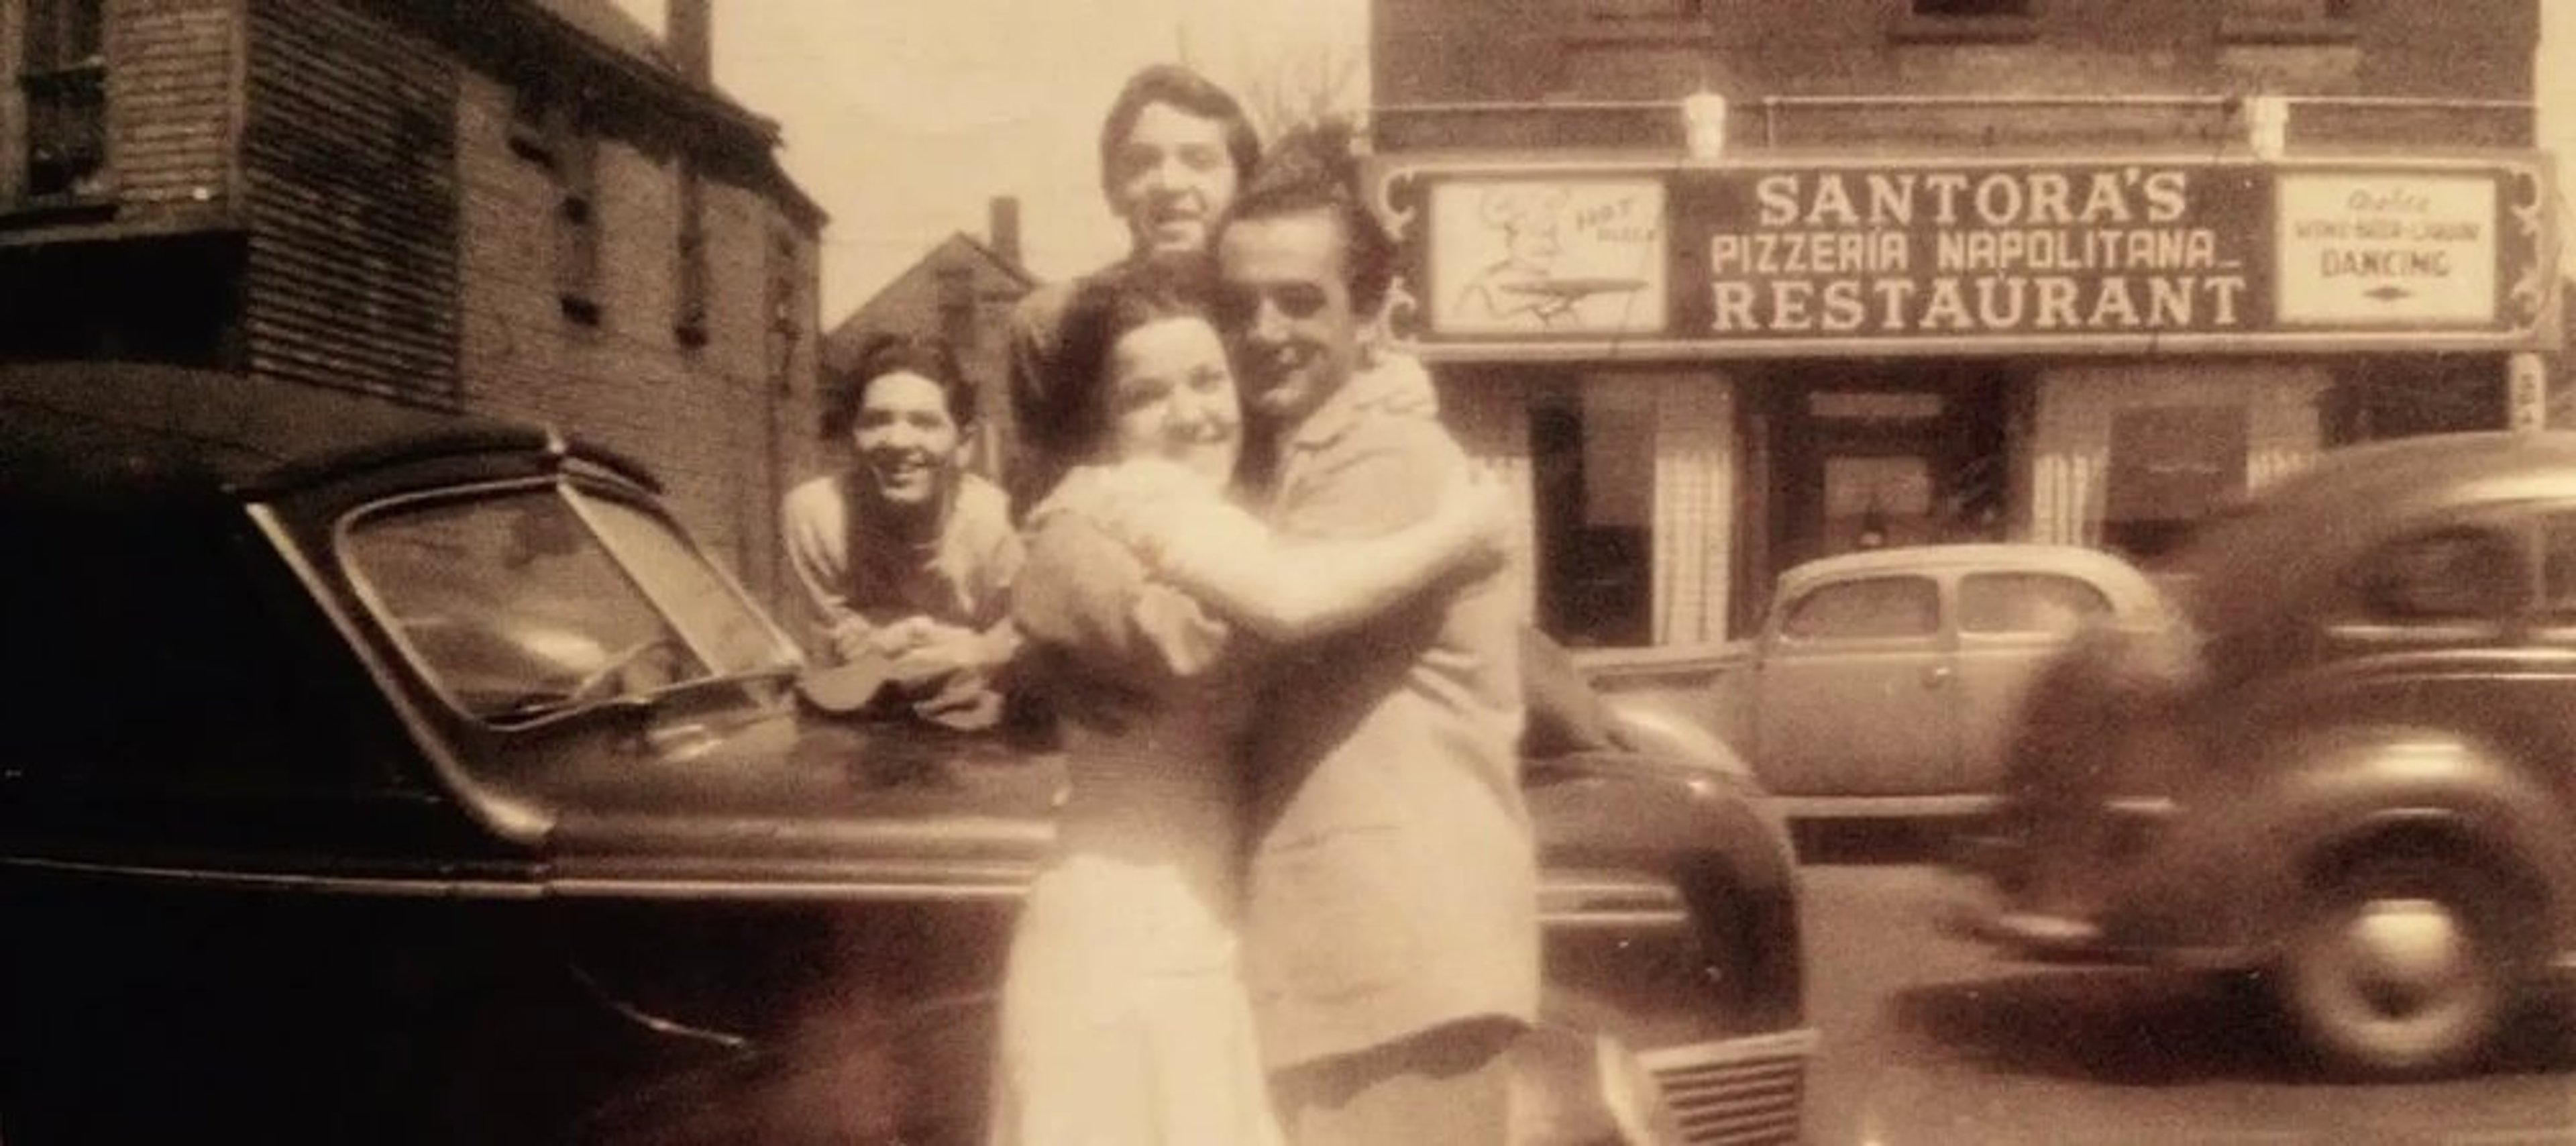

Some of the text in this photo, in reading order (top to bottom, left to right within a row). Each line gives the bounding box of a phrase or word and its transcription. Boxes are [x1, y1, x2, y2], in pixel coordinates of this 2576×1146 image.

[1756, 167, 2188, 226] SANTORA'S
[2321, 249, 2450, 278] DANCING
[1712, 276, 2247, 331] RESTAURANT
